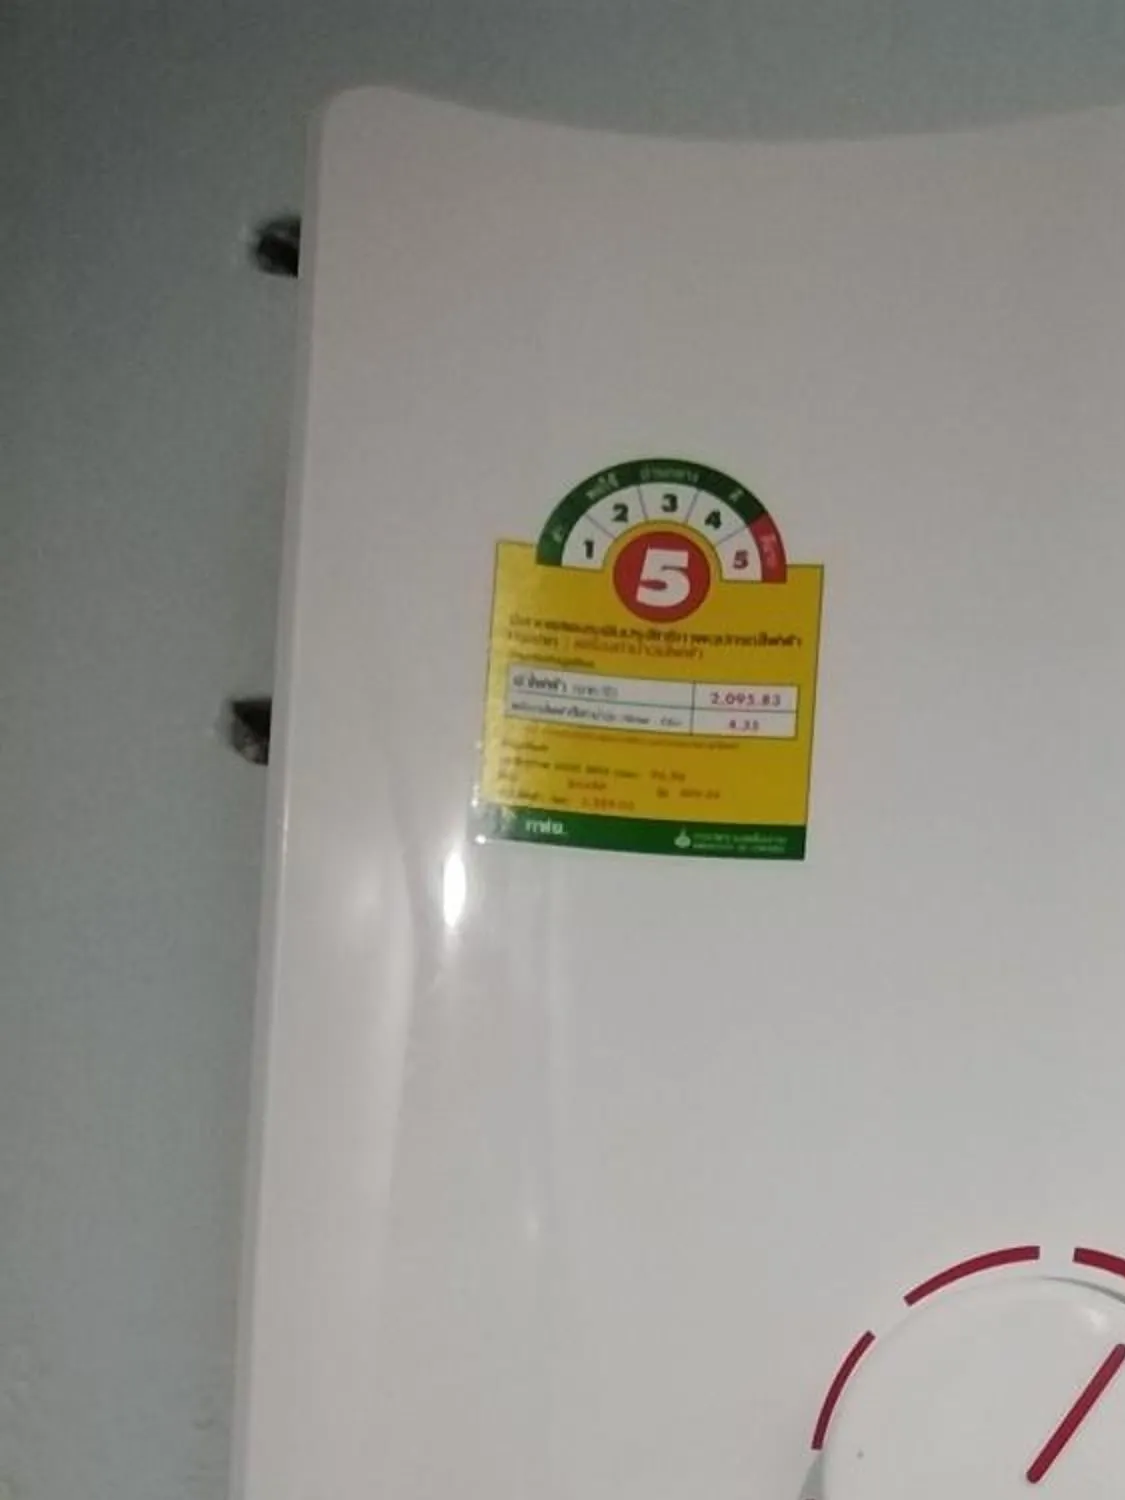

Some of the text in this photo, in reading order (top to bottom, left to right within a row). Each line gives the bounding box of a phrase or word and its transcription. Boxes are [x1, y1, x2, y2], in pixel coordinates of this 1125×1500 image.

[584, 541, 594, 559] 1
[611, 504, 629, 523] 2
[661, 494, 678, 512] 3
[704, 510, 721, 530] 4
[732, 550, 749, 569] 5
[636, 545, 691, 608] 5
